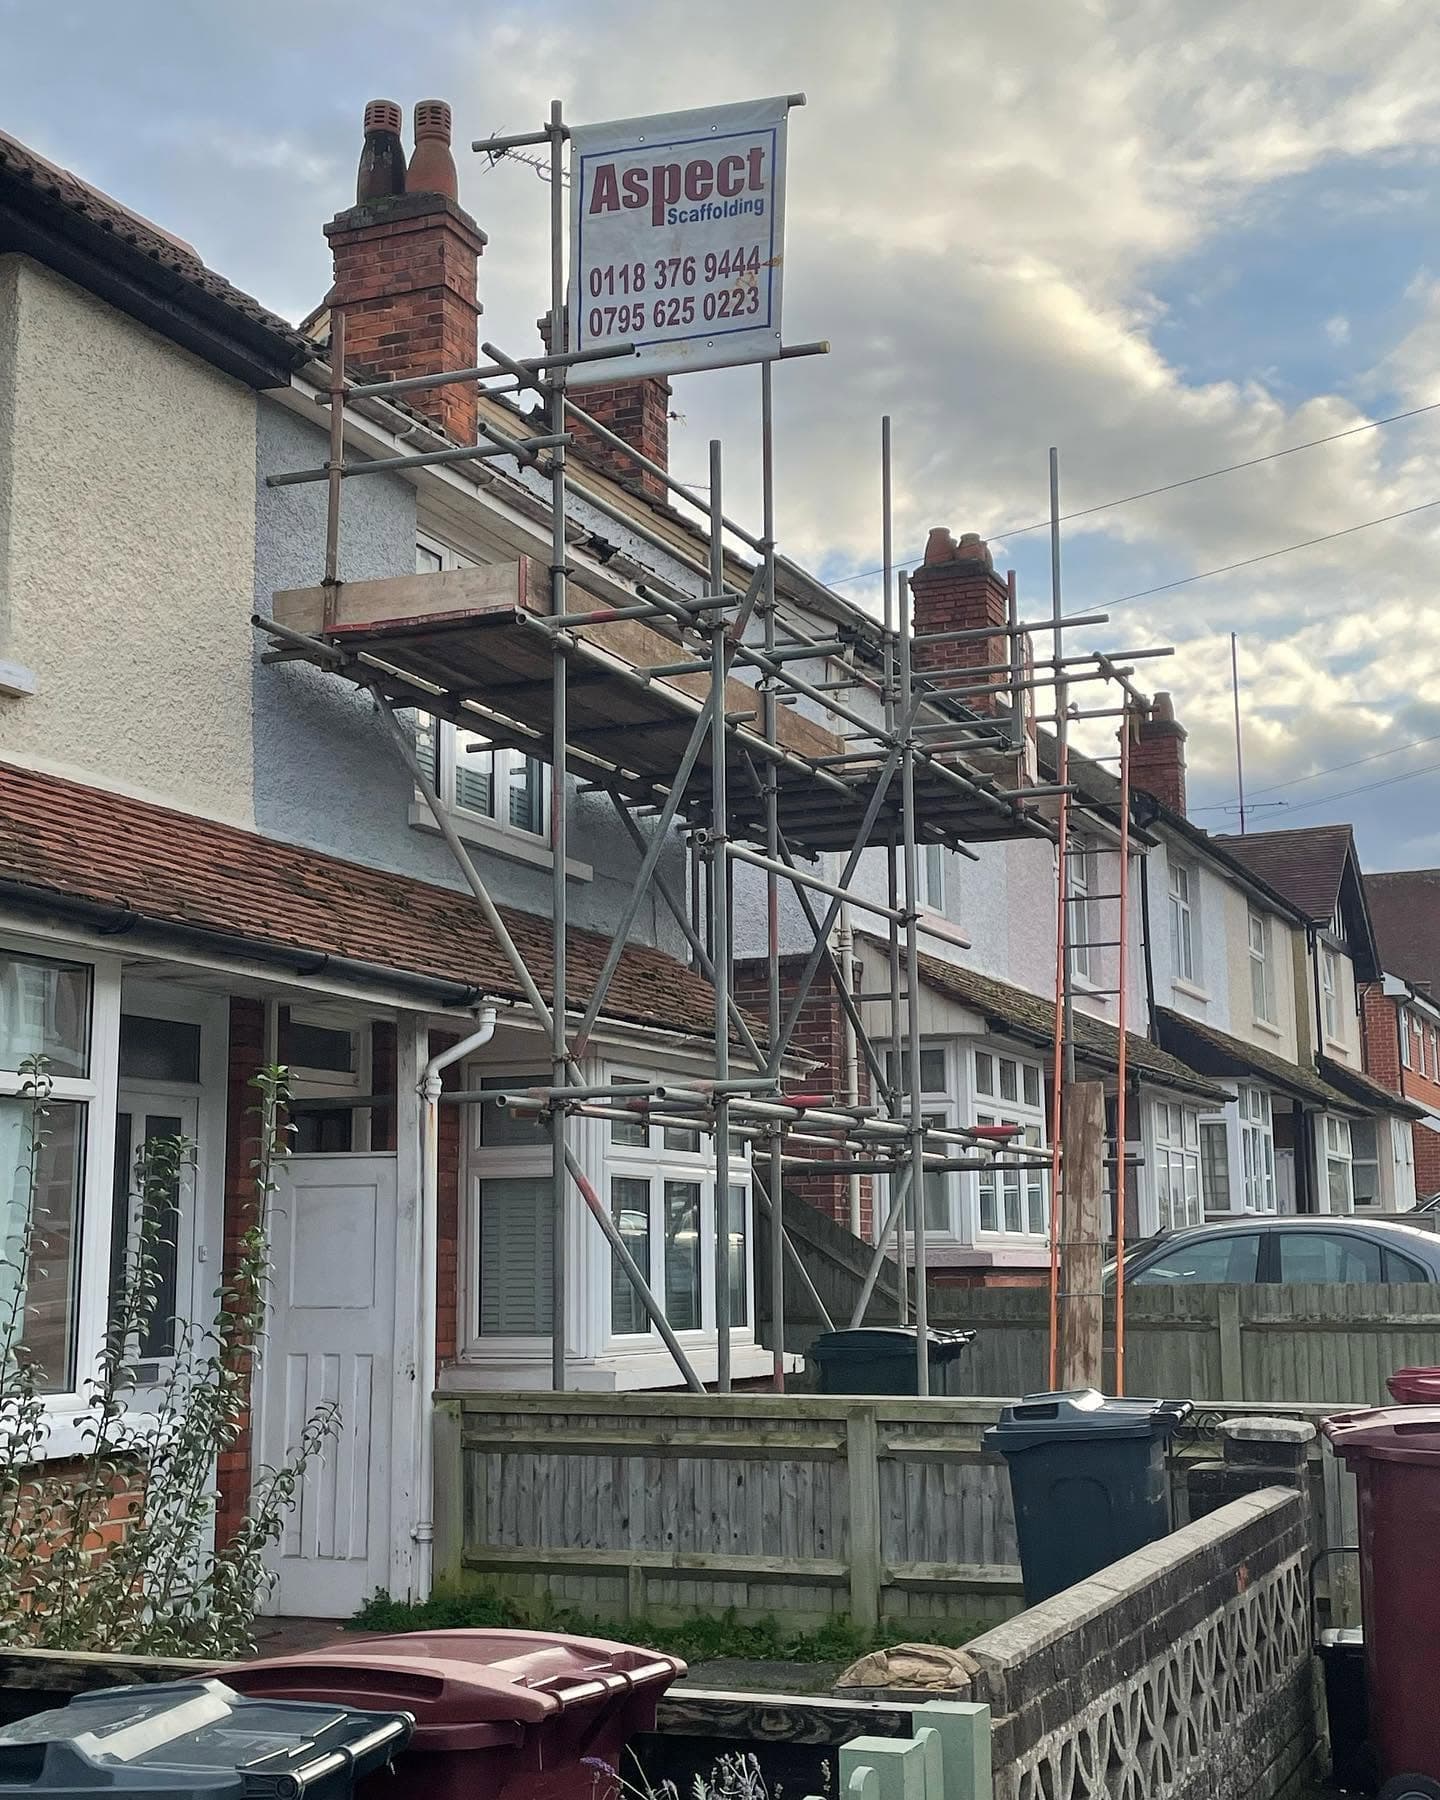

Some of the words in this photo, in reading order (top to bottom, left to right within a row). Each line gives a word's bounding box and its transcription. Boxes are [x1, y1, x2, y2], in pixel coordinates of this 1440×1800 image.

[589, 147, 765, 226] Aspect
[667, 198, 764, 225] Scaffolding
[590, 263, 645, 297] 0118
[654, 256, 696, 290] 376
[704, 245, 760, 283] 9444
[589, 303, 645, 337] 0795
[653, 296, 695, 328] 625
[703, 286, 759, 320] 0223
